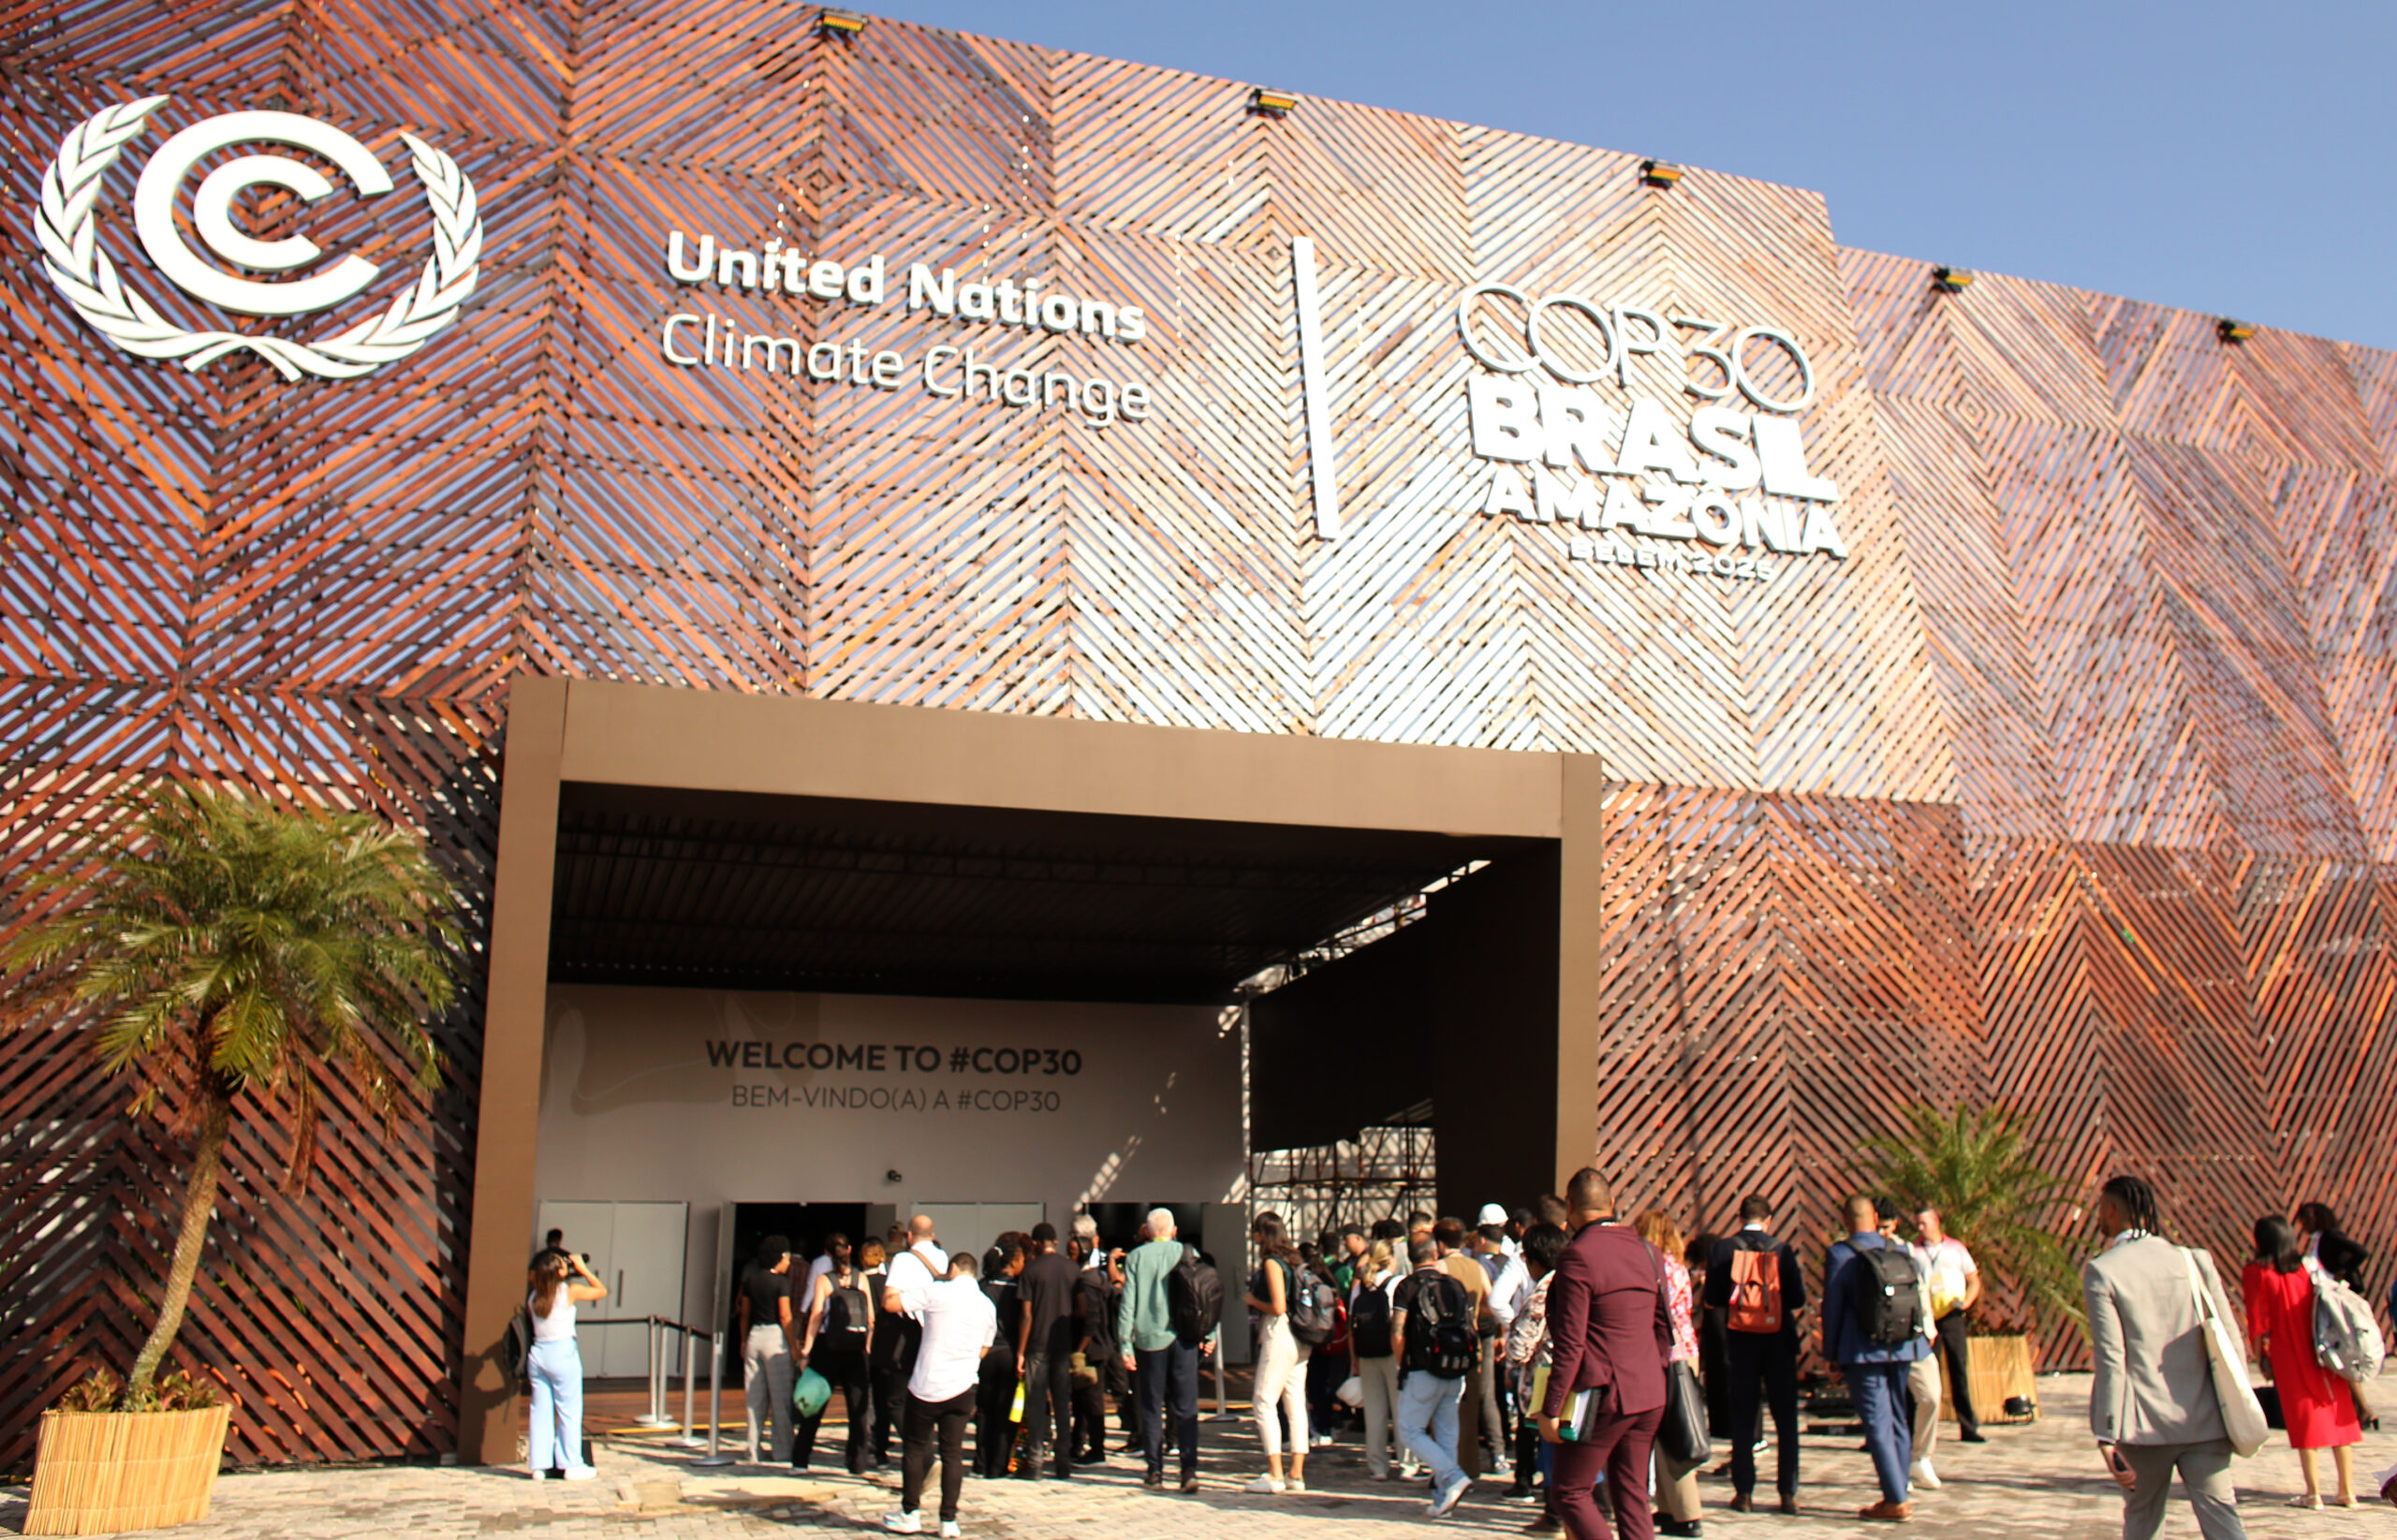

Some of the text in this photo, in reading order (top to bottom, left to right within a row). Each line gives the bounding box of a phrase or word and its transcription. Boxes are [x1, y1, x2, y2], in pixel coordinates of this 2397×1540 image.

[666, 230, 1147, 342] United Nations
[662, 312, 1152, 428] Climate Change
[1459, 281, 1816, 413] COP30
[1692, 549, 1776, 582] 2025
[705, 1040, 1083, 1076] WELCOME TO #COP30
[731, 1085, 1062, 1113] BEM-VINDO(A) A #COP30
